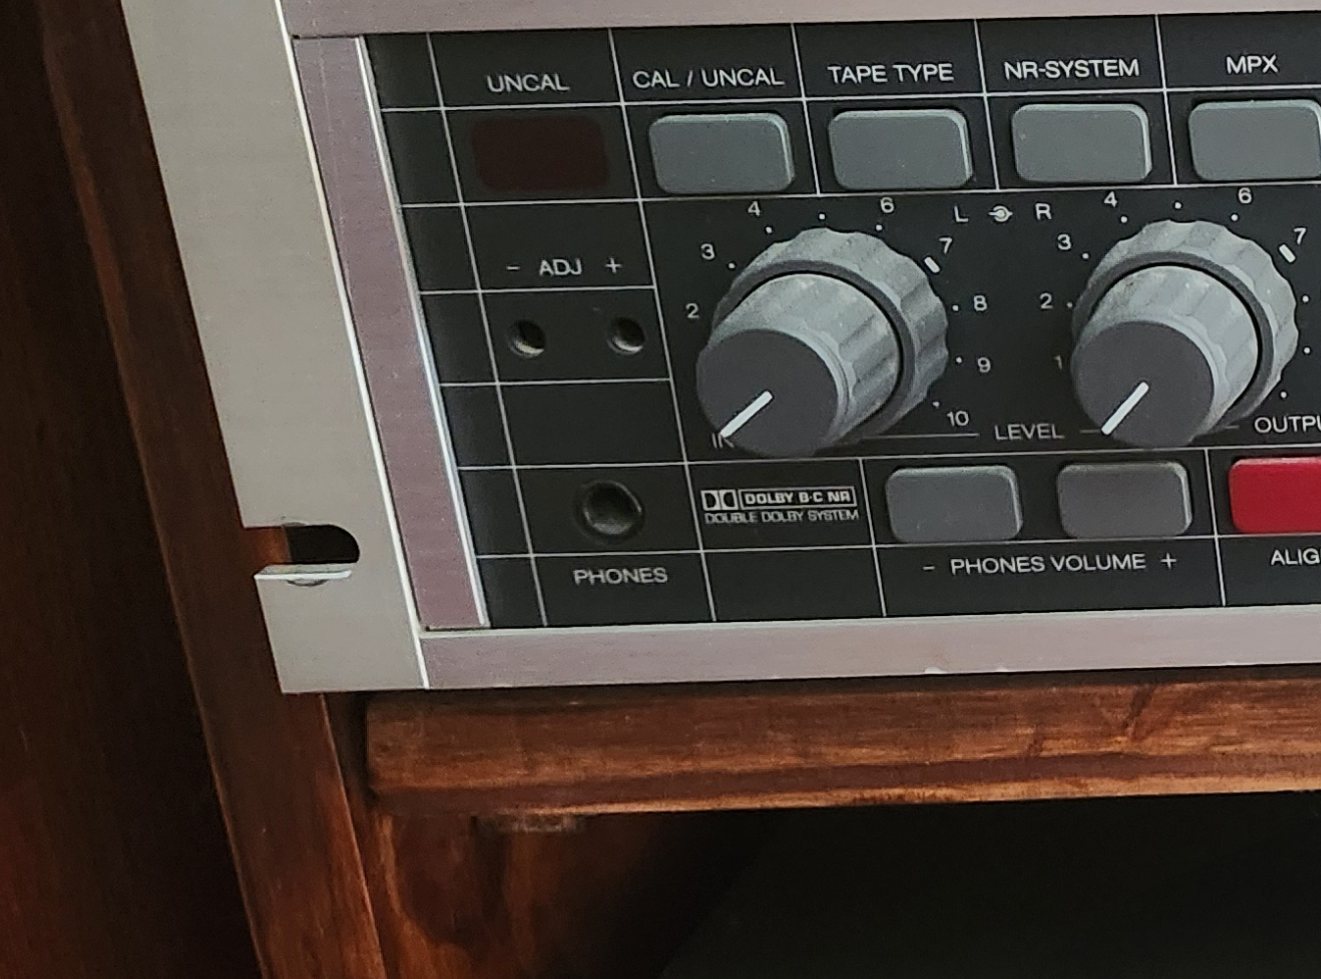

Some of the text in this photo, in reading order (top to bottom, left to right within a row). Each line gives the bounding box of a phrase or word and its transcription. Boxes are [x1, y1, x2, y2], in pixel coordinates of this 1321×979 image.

[1004, 58, 1140, 80] NR-SYSTEM
[1226, 54, 1278, 74] MPX
[632, 69, 680, 89] CAL
[701, 67, 785, 87] UNCAL
[827, 63, 955, 84] TAPE TYPE
[487, 73, 570, 93] UNCAL
[1103, 191, 1118, 207] 4
[1238, 187, 1252, 204] 6
[747, 200, 761, 216] 4
[880, 196, 895, 214] 6
[954, 202, 1052, 223] L R
[1057, 233, 1072, 250] 3
[1293, 227, 1307, 245] 7
[700, 243, 715, 260] 3
[939, 237, 953, 254] 7
[539, 258, 582, 276] ADJ
[973, 295, 988, 311] 8
[1039, 292, 1053, 309] 2
[685, 302, 699, 319] 2
[977, 356, 991, 373] 9
[946, 410, 970, 426] 10
[994, 423, 1065, 441] LEVEL
[744, 492, 794, 505] DOLBY
[826, 489, 853, 504] NR
[703, 509, 859, 525] DOUBLE DOLBY SYSTEM
[950, 556, 1046, 575] PHONES
[1050, 553, 1147, 572] VOLUME
[572, 567, 668, 585] PHONES
